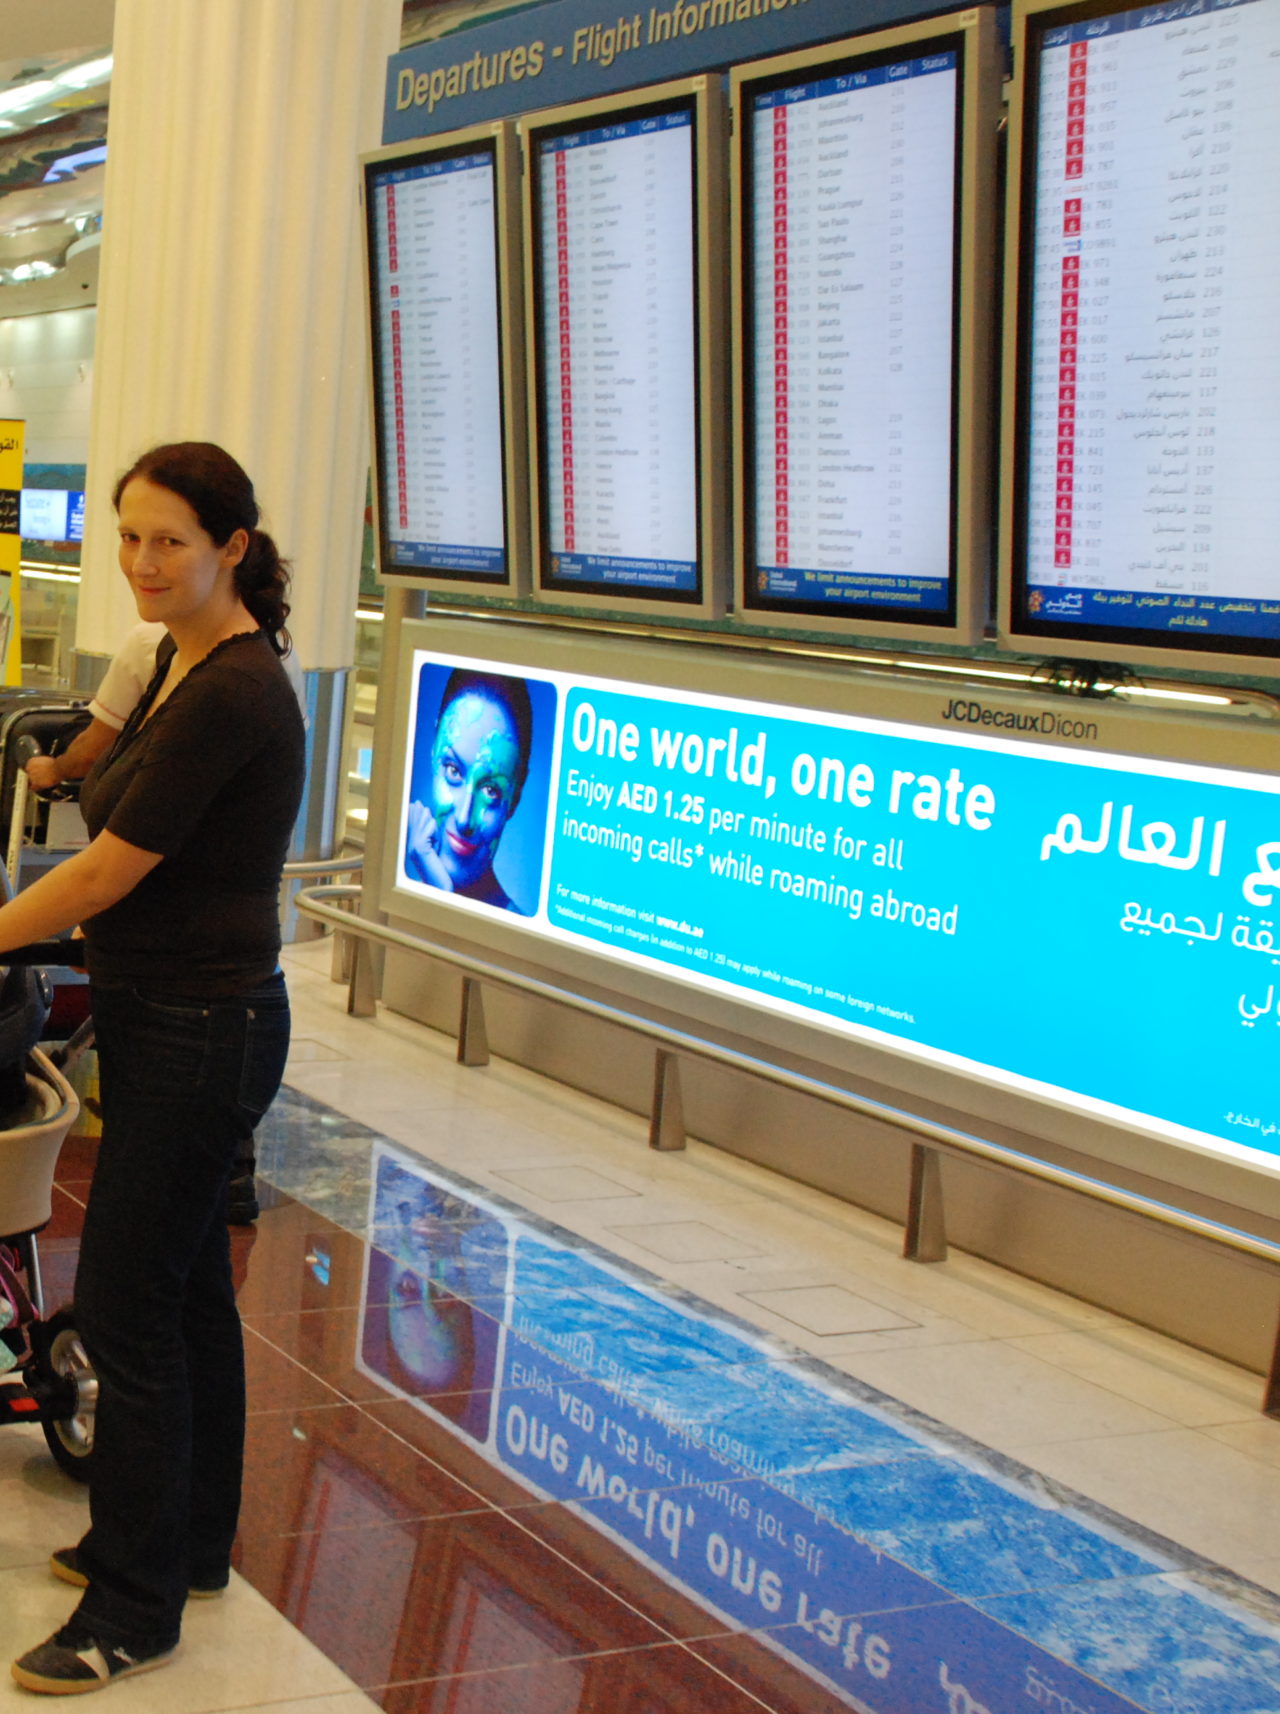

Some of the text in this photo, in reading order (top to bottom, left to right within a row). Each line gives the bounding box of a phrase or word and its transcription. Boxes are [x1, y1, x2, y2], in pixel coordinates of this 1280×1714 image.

[396, 37, 544, 112] Departures
[572, 13, 641, 66] Flight
[647, 0, 812, 45] Informatio
[889, 65, 908, 77] Gate
[921, 56, 948, 71] Status
[572, 702, 996, 831] One world, one rate
[567, 769, 904, 871] Enjoy AED 1.25 per minute for all
[1040, 801, 1227, 877] العالم
[556, 883, 704, 939] For more information visit www.du.ae
[562, 810, 643, 862] incoming
[709, 850, 763, 886] while
[769, 868, 864, 920] roaming
[870, 889, 959, 936] abroad
[1120, 902, 1224, 946] لجميع
